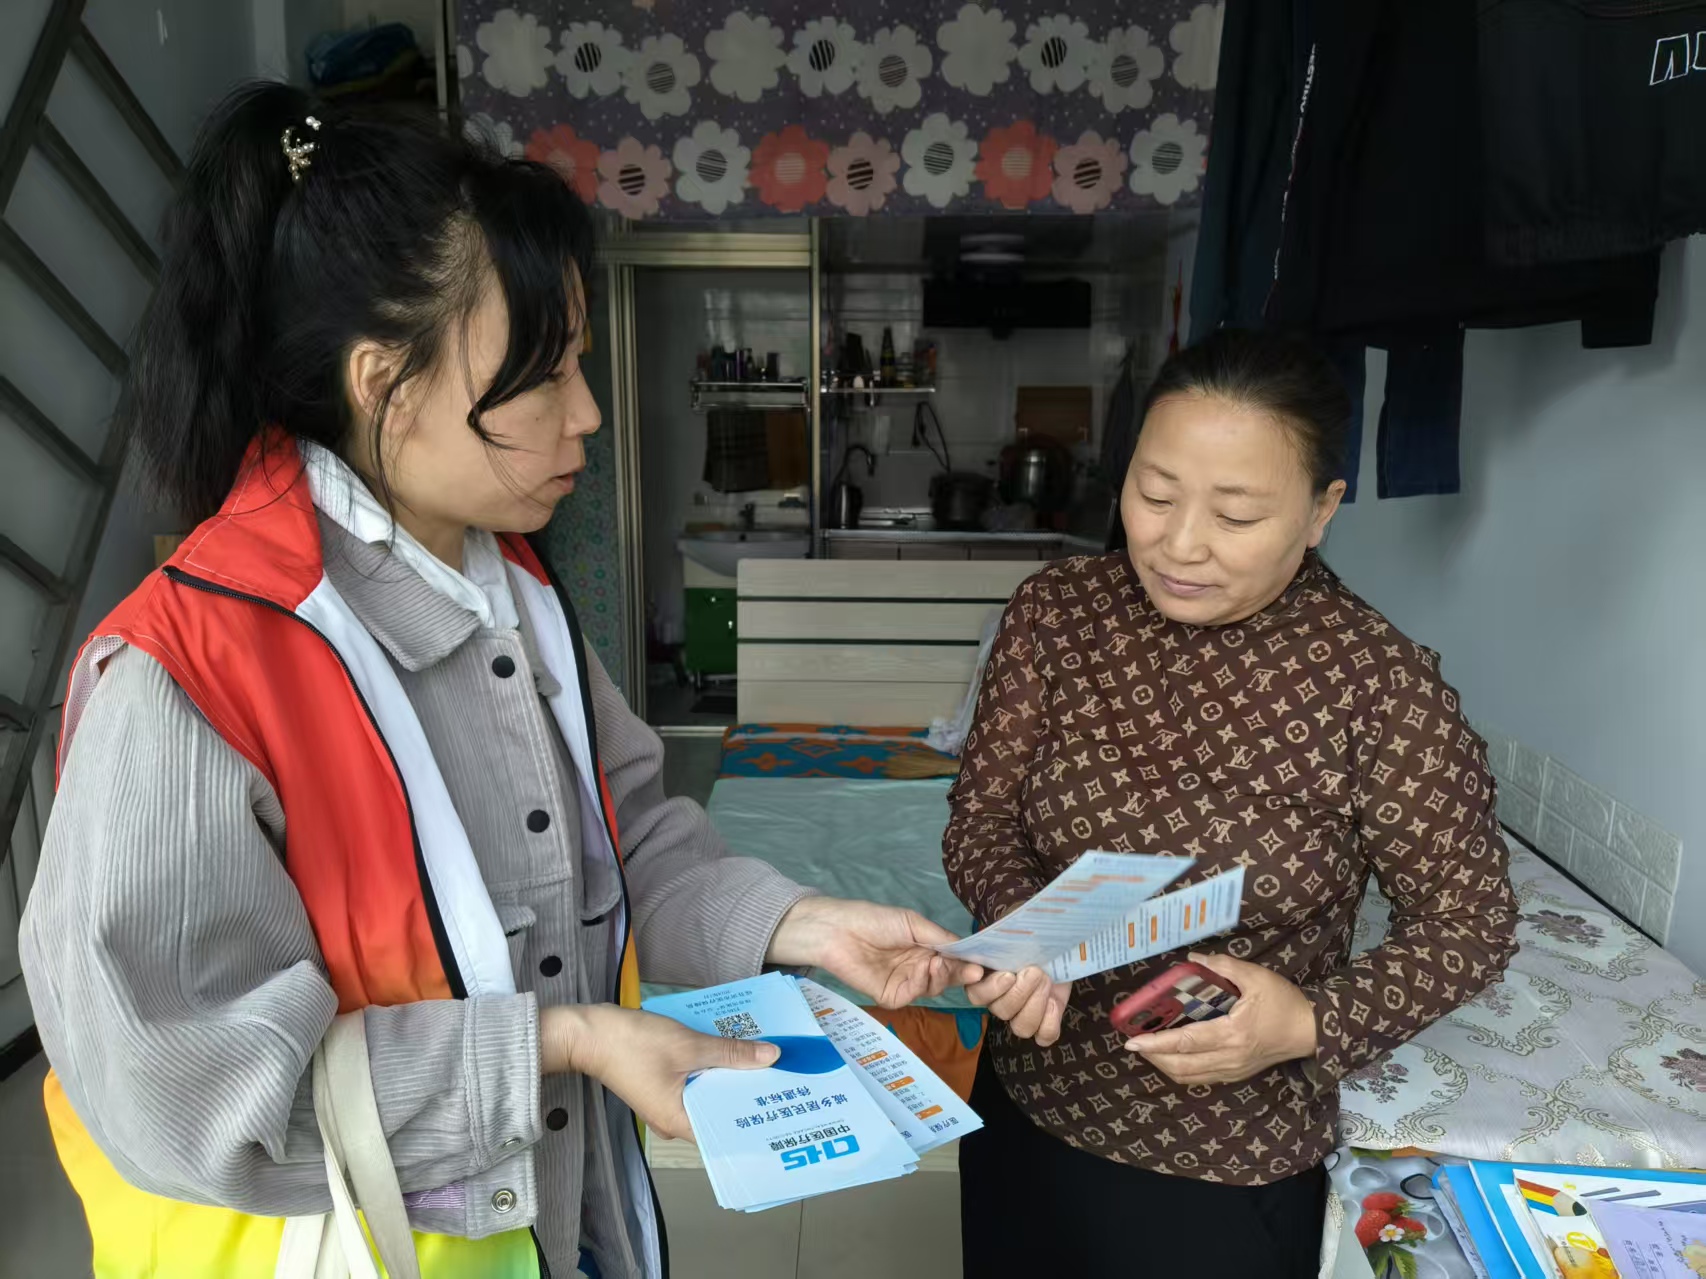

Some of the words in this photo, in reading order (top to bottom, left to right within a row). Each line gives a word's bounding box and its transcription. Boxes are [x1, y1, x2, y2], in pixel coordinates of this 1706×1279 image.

[734, 1093, 848, 1129] 城乡居民医疗保险
[754, 1085, 812, 1107] 待遇标准
[768, 1124, 851, 1152] 中国医疗保障
[780, 1134, 860, 1171] CHS
